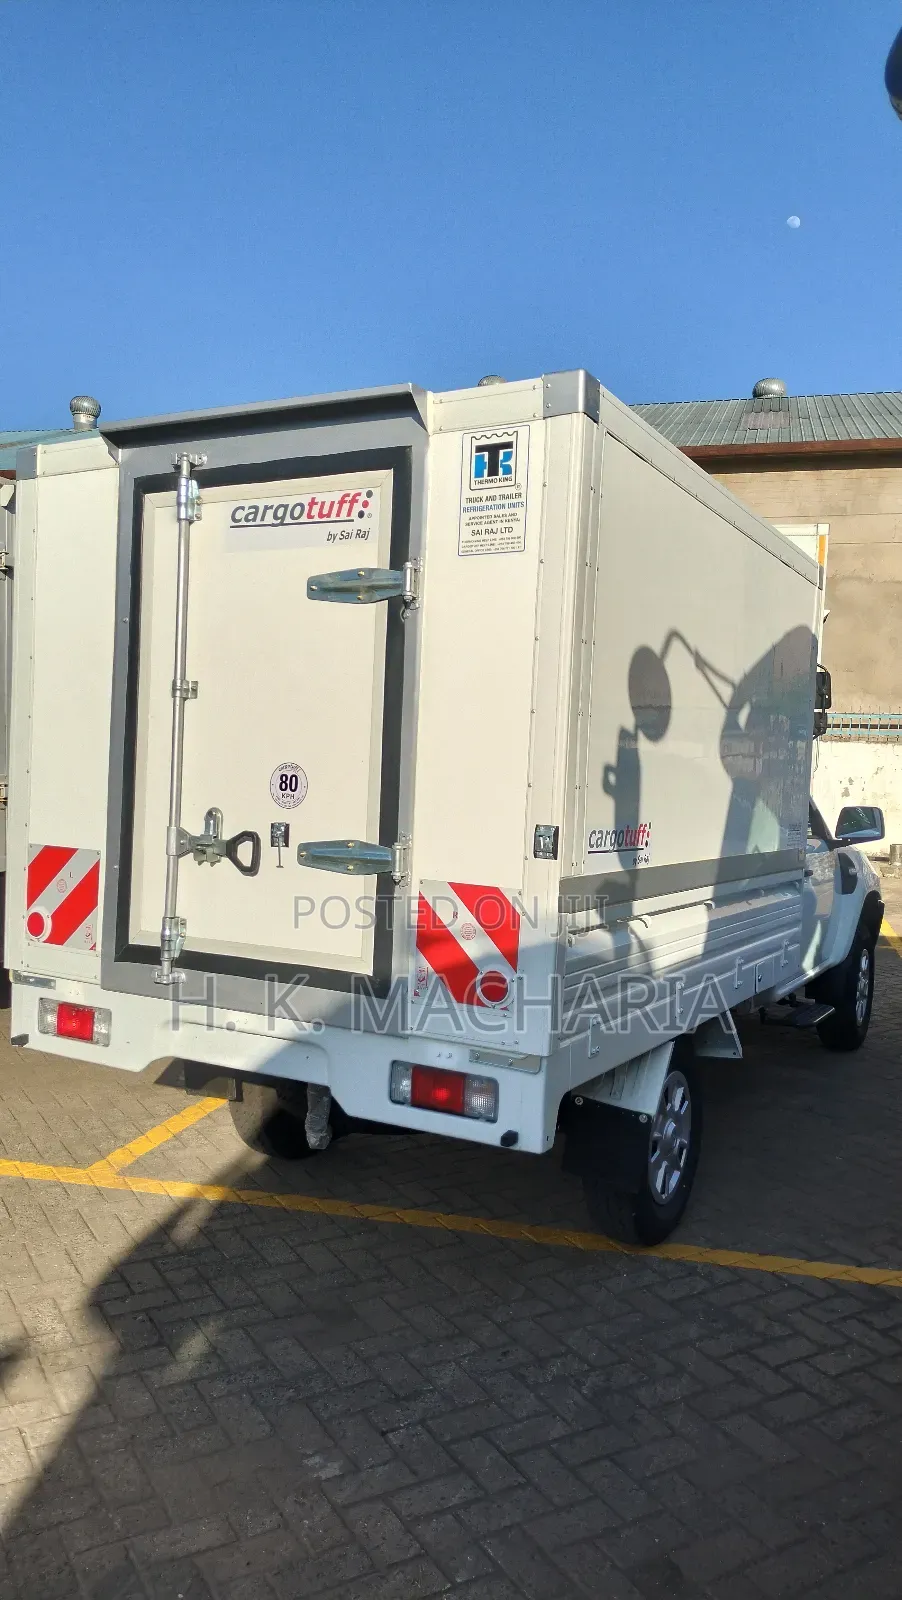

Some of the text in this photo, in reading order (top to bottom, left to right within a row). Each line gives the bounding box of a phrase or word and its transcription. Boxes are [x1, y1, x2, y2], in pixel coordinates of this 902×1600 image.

[474, 477, 498, 486] THERMO
[465, 492, 522, 504] TRUCK AND TRAILER
[462, 501, 525, 513] REFRIGERATION UNITS
[326, 528, 371, 543] by Sai Raj
[471, 526, 514, 537] SAI RAJ LTD
[279, 774, 298, 792] 80
